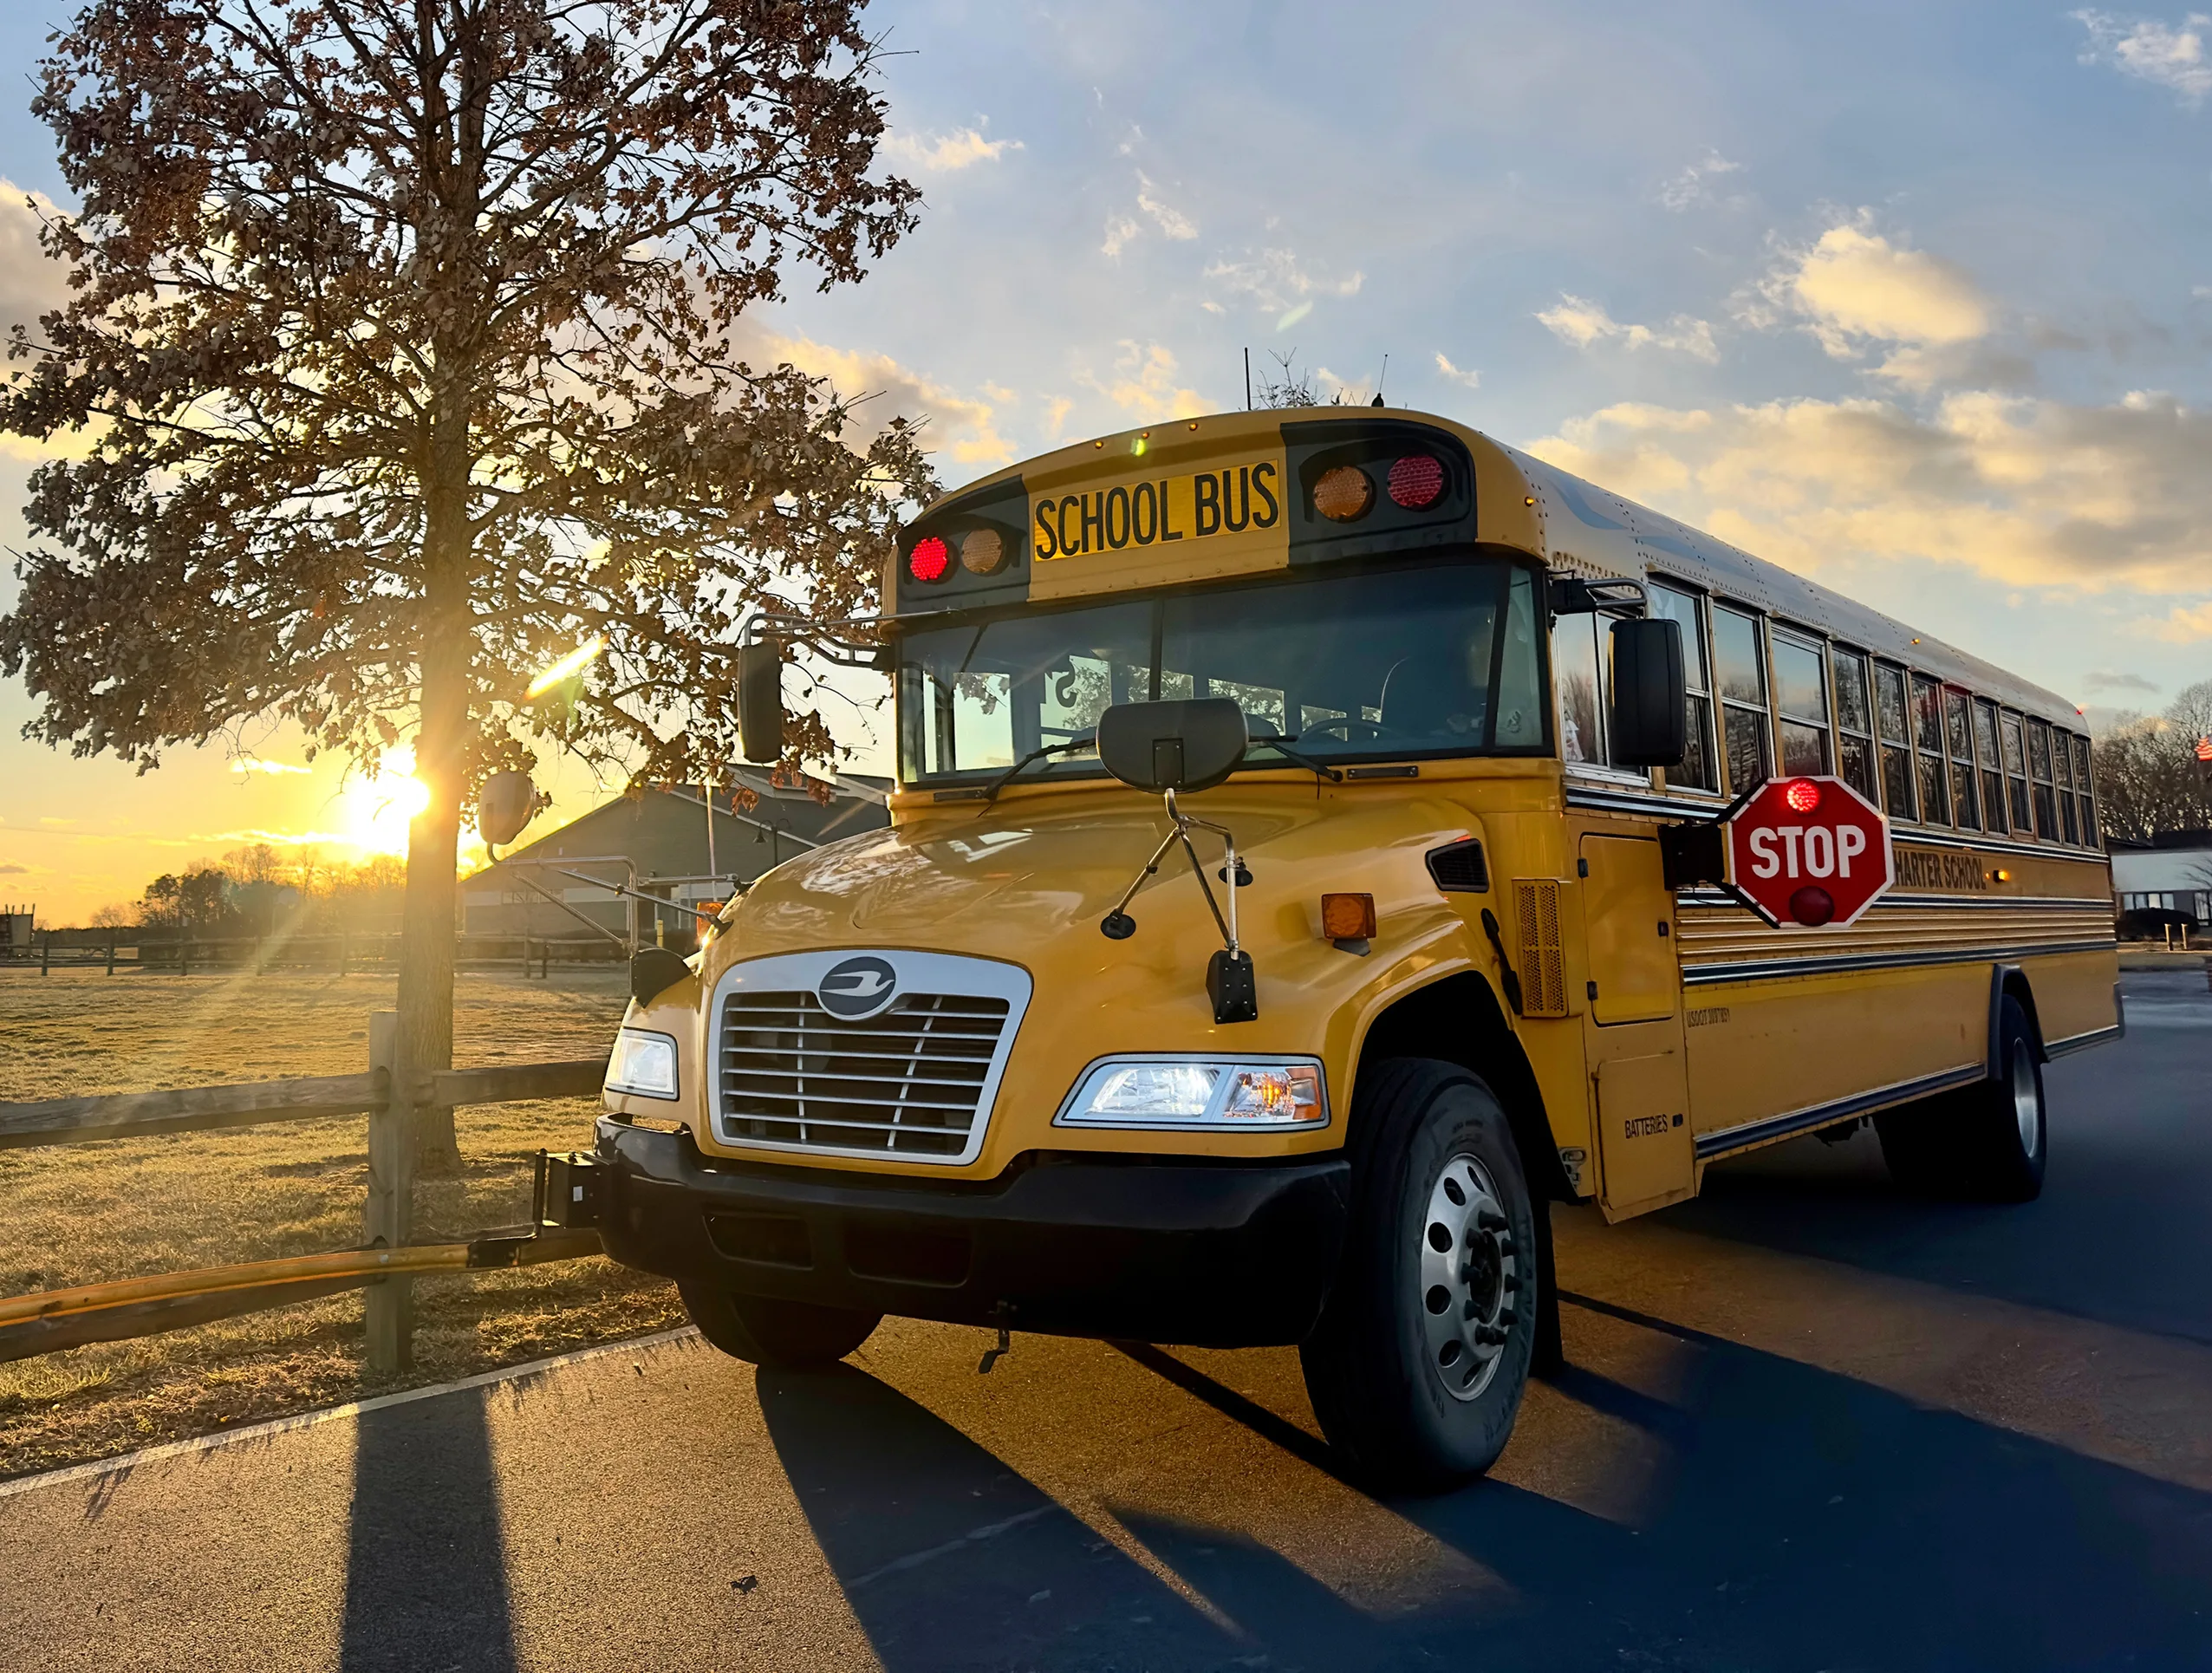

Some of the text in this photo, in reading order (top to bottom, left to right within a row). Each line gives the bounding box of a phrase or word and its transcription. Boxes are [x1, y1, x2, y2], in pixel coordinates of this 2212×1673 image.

[1035, 462, 1279, 560] SCHOOL BUS
[1749, 824, 1866, 879] STOP
[1942, 855, 1987, 890] SCHOOL
[1624, 1114, 1668, 1139] BATTERIES
